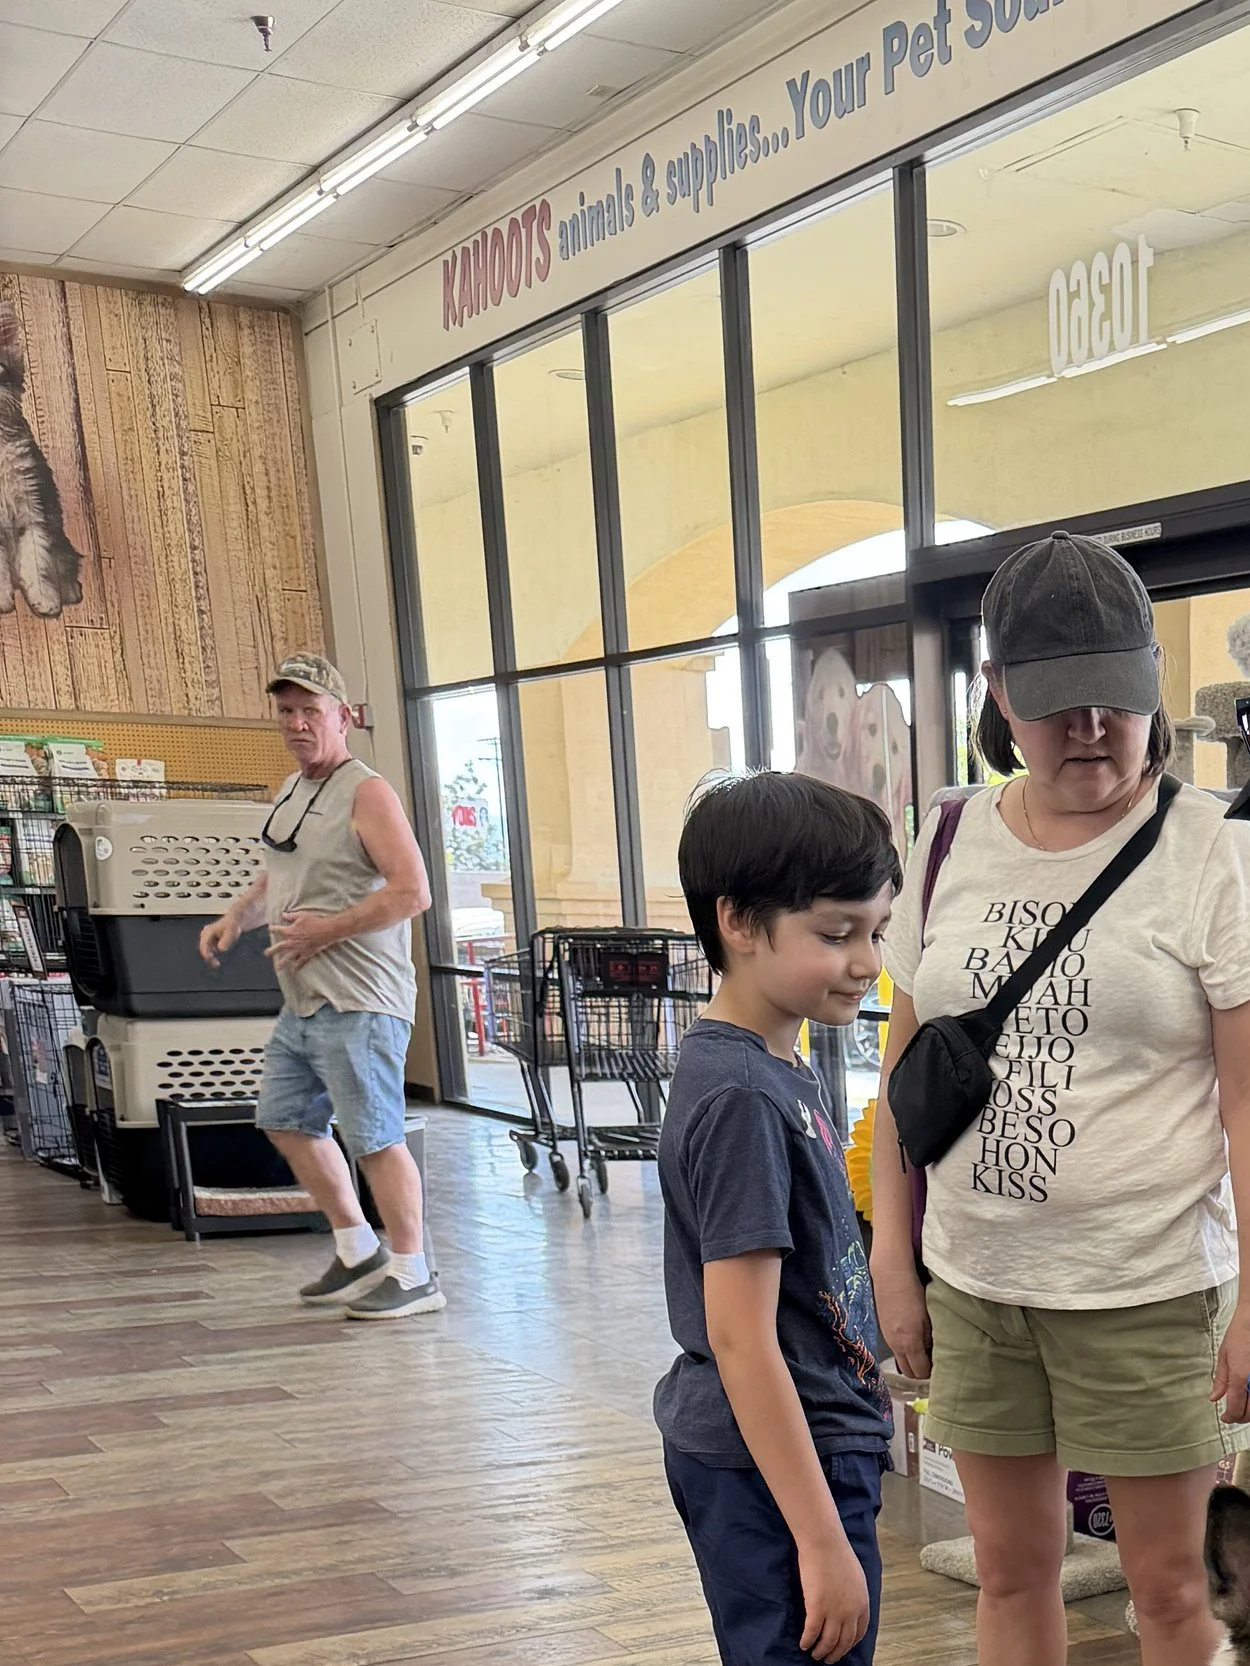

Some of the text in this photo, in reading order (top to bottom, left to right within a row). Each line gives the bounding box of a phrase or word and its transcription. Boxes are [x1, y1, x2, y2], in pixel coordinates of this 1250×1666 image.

[442, 198, 552, 331] KAHOOTS
[558, 167, 635, 261] animals
[641, 152, 660, 217] &
[882, 0, 952, 95] Pet
[981, 900, 1076, 927] BISO
[999, 926, 1094, 953] KIU
[961, 947, 1086, 978] BAIO
[1012, 1006, 1089, 1036] ETO
[994, 1033, 1075, 1063] EIJO
[992, 1080, 1057, 1116] OSS
[977, 1105, 1076, 1147] BESO
[979, 1135, 1060, 1177] HON
[970, 1161, 1048, 1203] KISS
